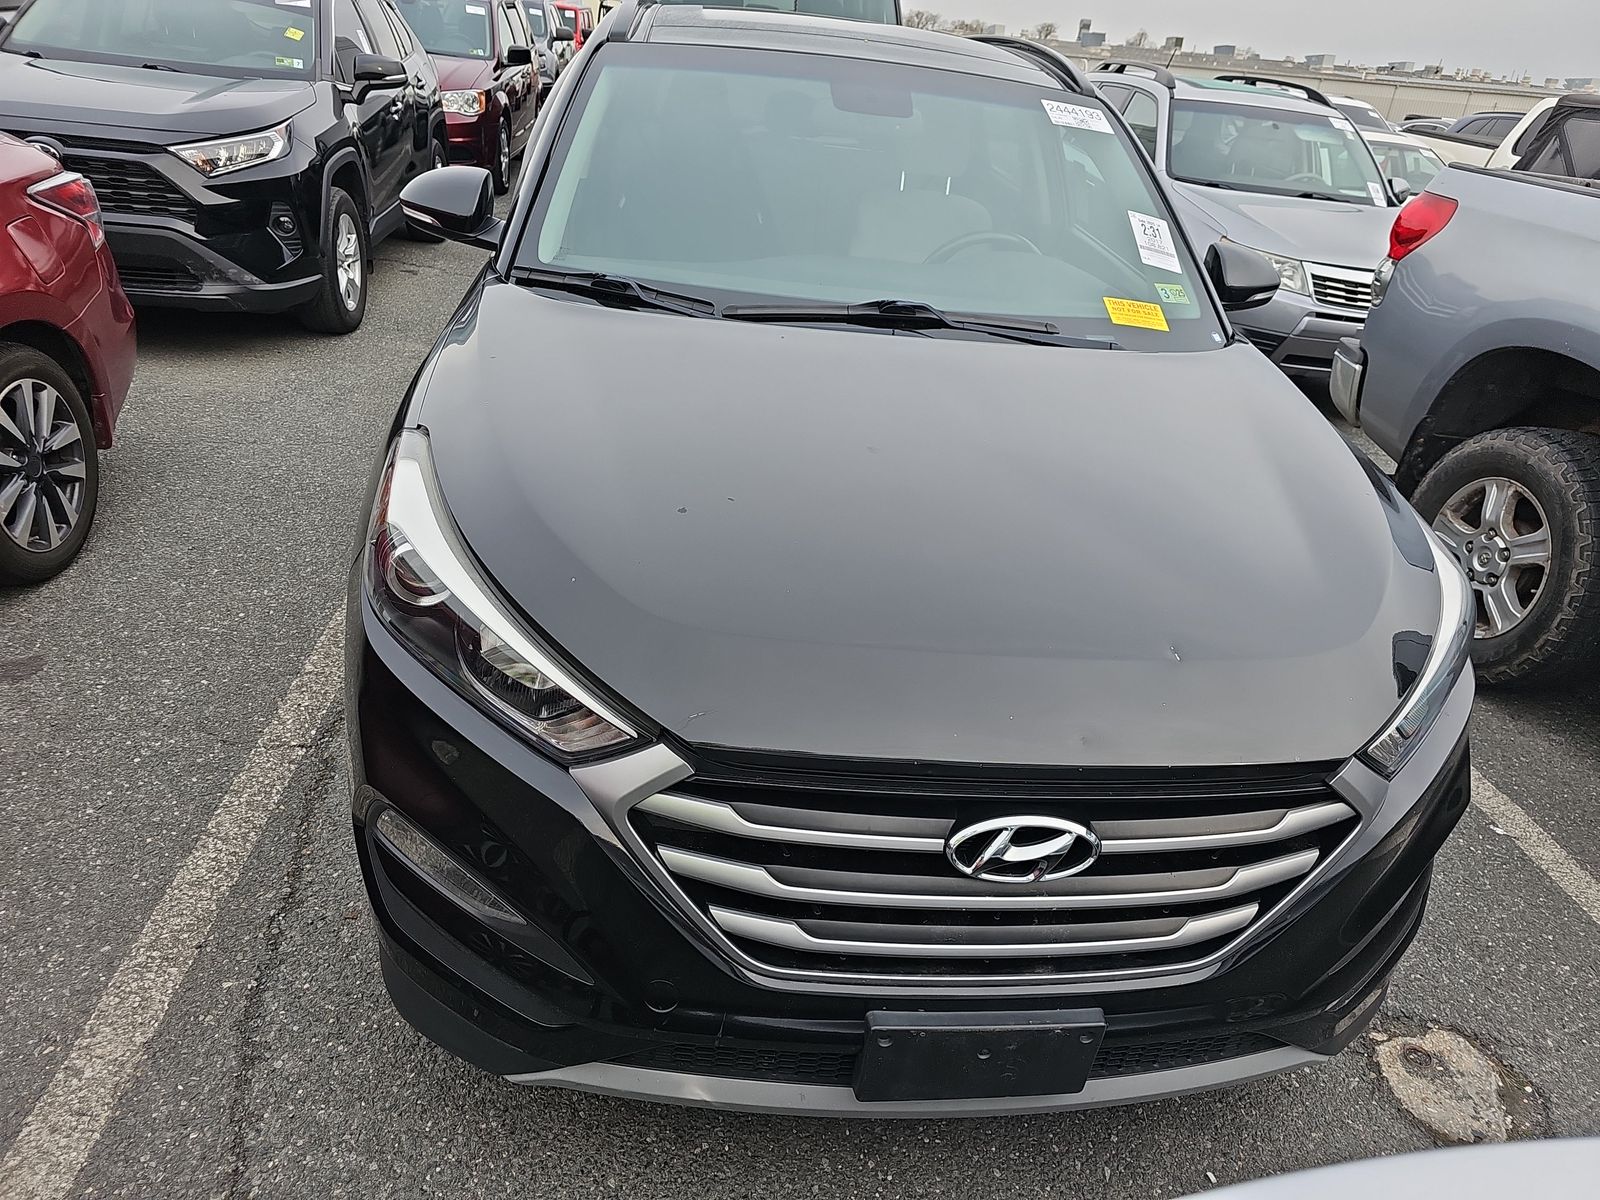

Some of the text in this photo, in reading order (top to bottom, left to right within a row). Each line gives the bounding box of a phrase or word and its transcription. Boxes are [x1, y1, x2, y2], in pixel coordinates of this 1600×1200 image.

[1046, 102, 1102, 121] 2444193
[1141, 223, 1162, 240] 2:31
[1161, 288, 1170, 299] 3
[1107, 299, 1160, 312] THIS VEHICLE
[1142, 310, 1160, 318] SALE
